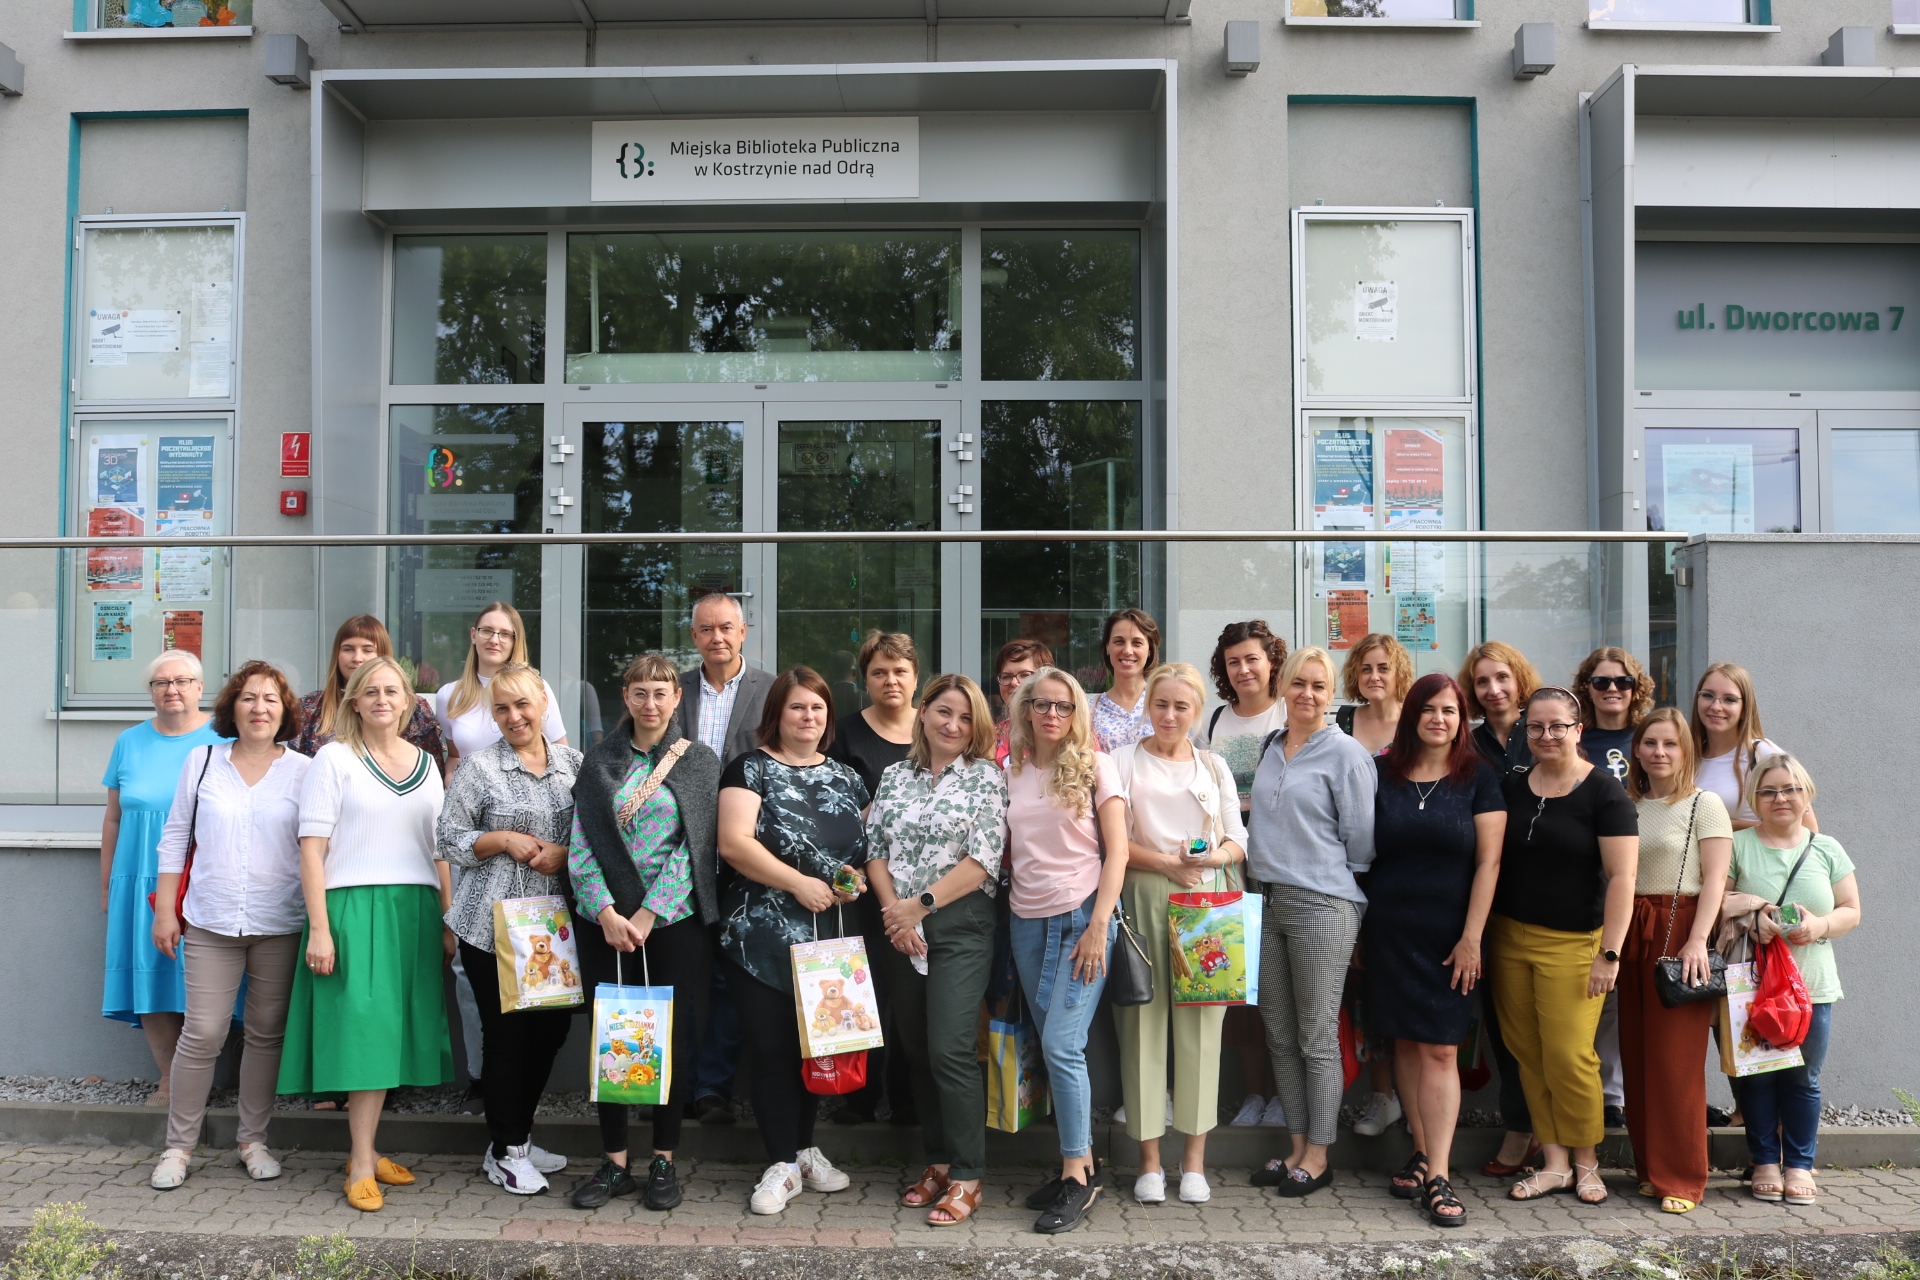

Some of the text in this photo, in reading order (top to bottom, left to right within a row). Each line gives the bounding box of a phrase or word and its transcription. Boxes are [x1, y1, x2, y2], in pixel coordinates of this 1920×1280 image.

[670, 138, 900, 158] Miejska Biblioteka Publiczna
[694, 160, 874, 179] w Kostrzynie nad Odrą
[97, 313, 121, 321] UWAGA
[1678, 302, 1905, 331] ul. Dworcowa 7
[103, 456, 118, 465] 3D
